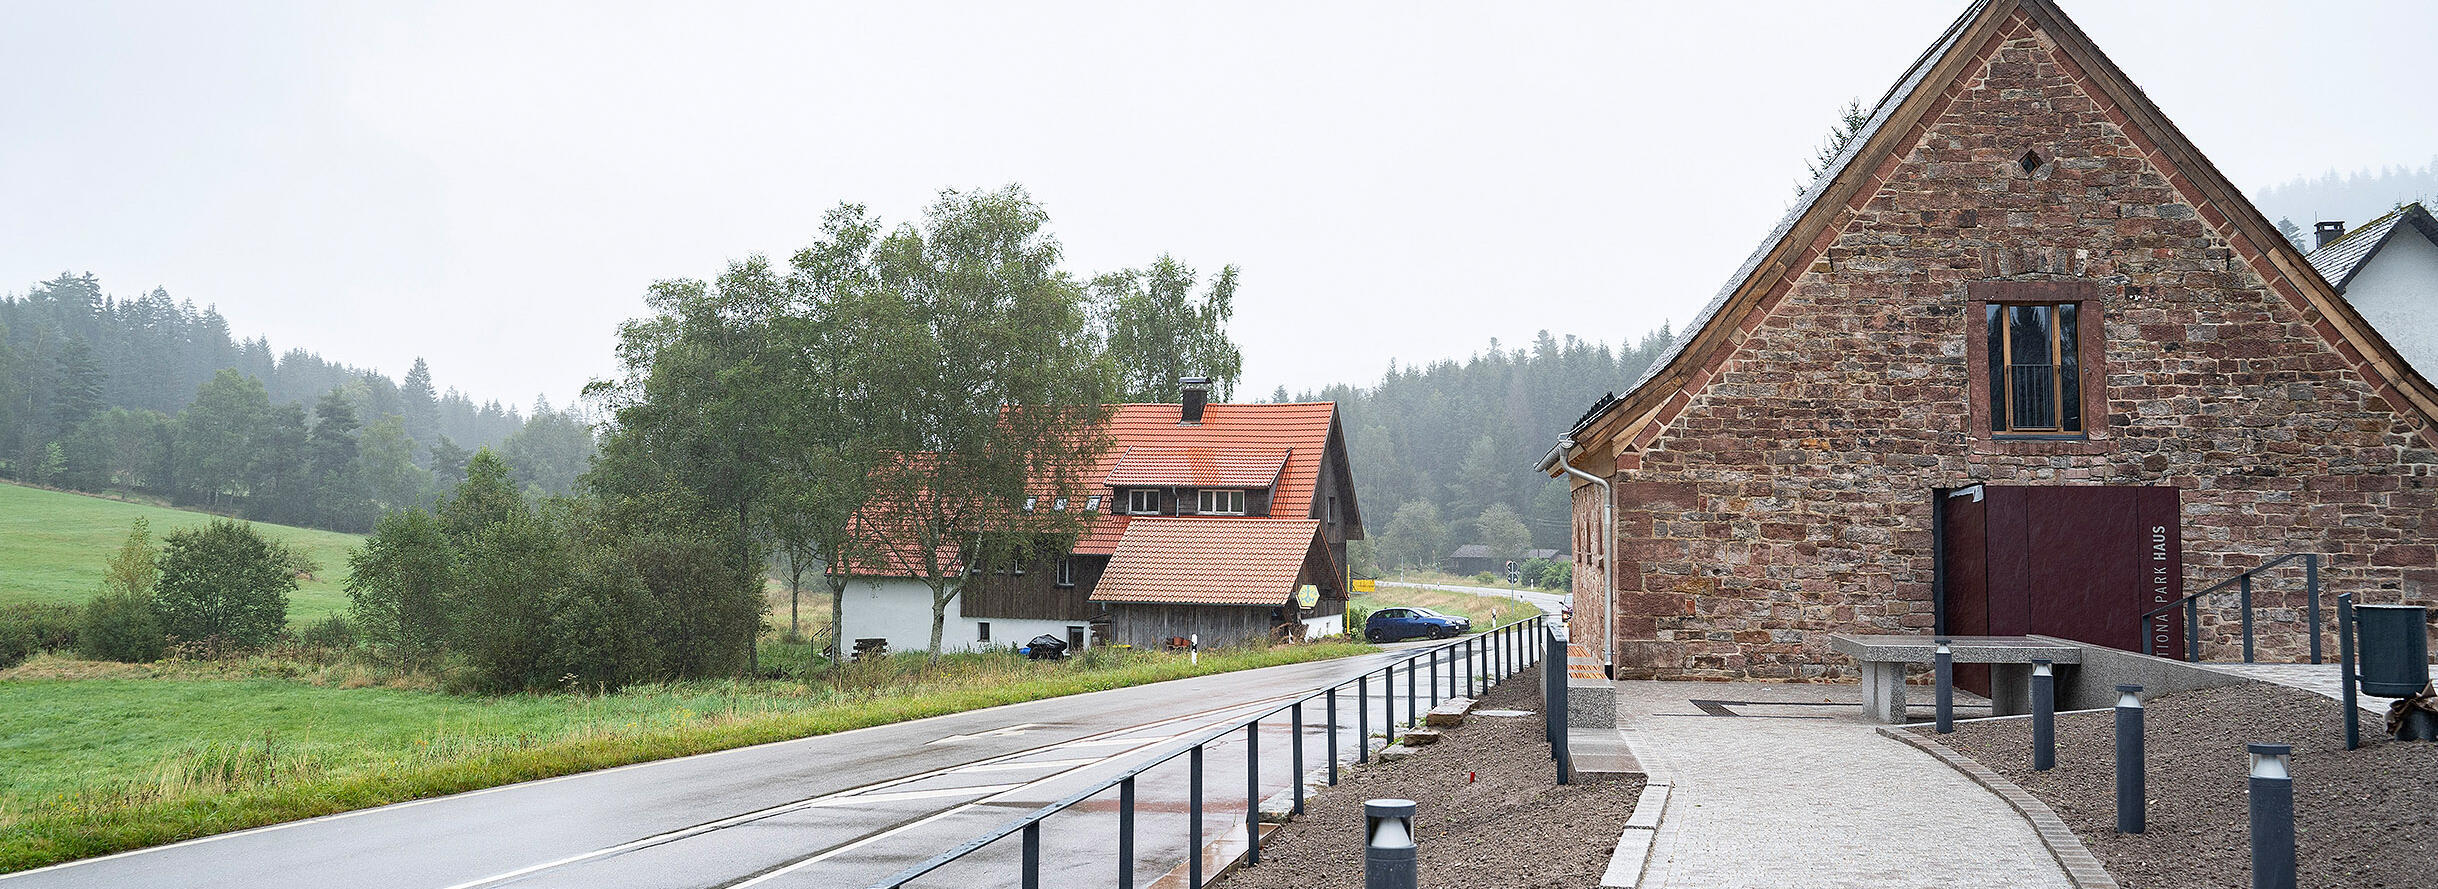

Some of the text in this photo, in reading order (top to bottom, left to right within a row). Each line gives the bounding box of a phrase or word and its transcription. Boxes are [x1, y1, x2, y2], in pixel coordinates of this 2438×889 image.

[2152, 525, 2169, 657] TIONA PARK HAUS
